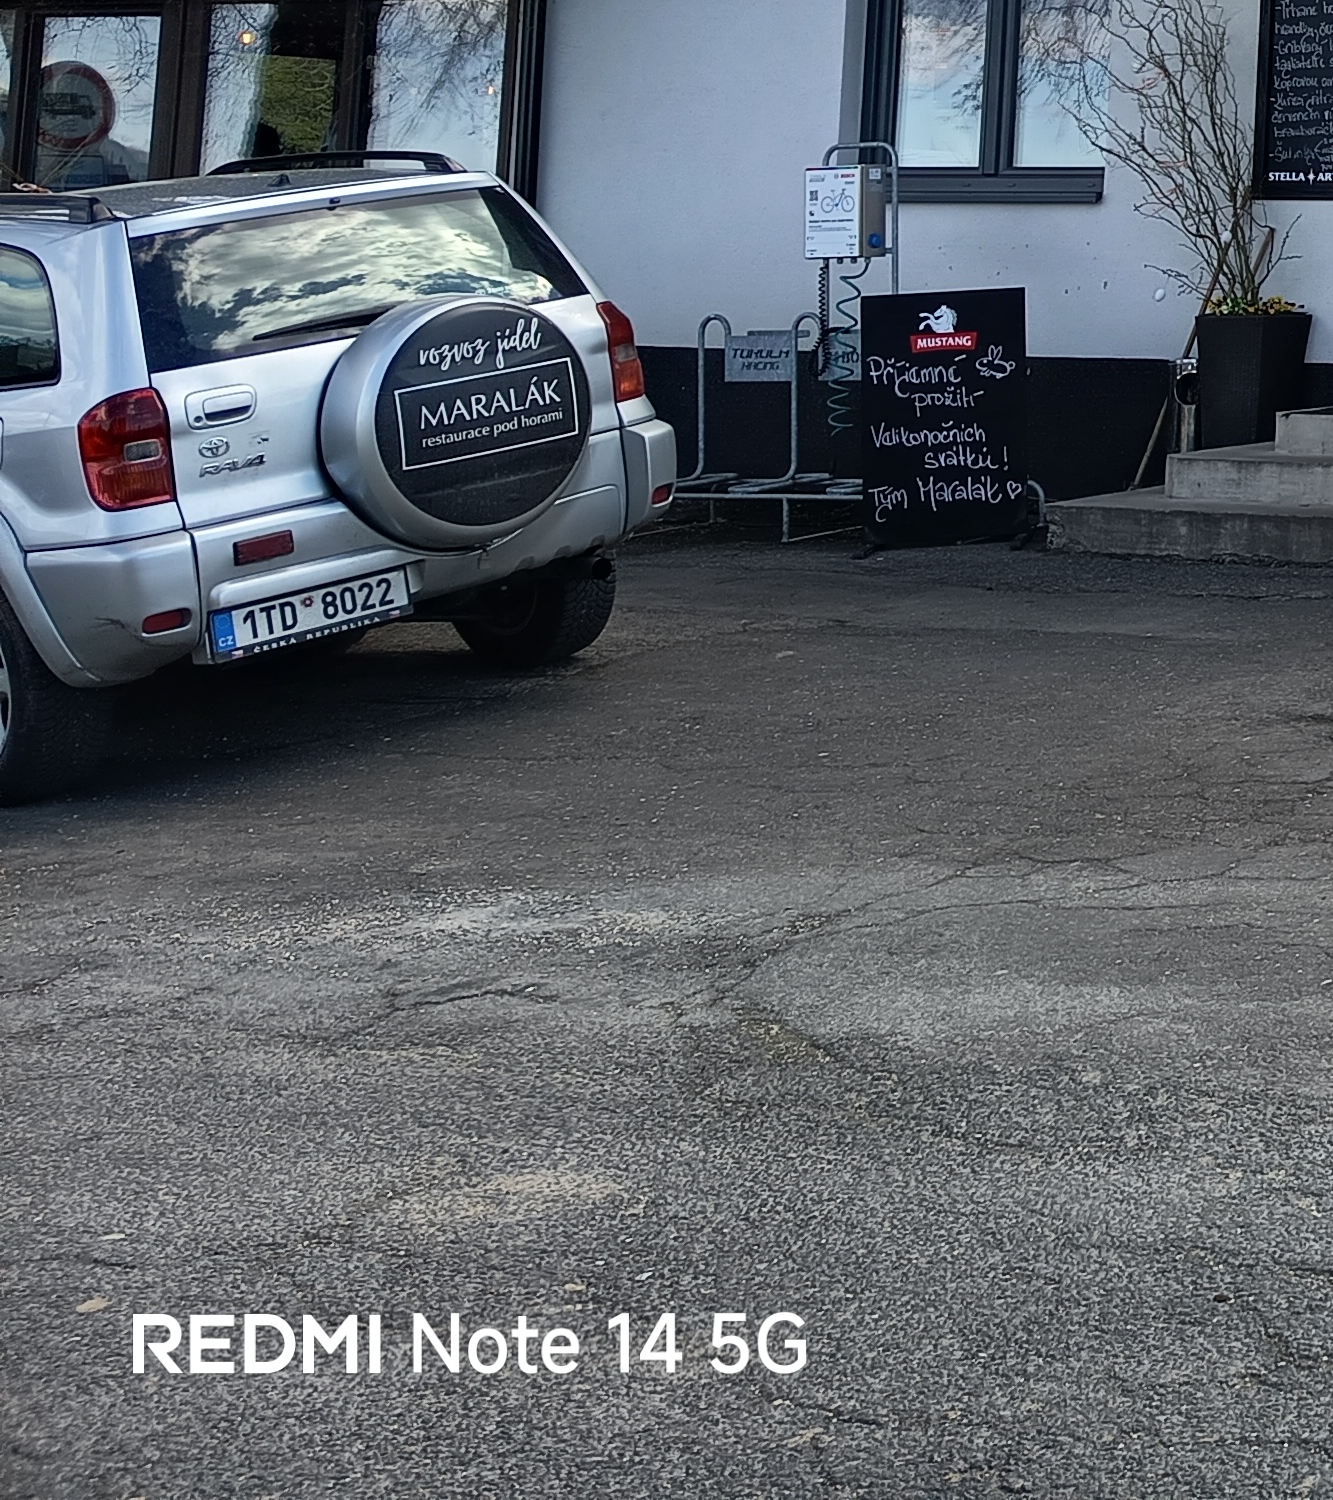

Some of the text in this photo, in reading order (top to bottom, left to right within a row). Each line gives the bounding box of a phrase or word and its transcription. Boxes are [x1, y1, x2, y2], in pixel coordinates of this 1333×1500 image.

[1267, 171, 1306, 182] STELLA
[418, 316, 542, 372] rozvoz jídel
[916, 335, 972, 350] MUSTANG
[866, 354, 967, 398] Příjemné
[420, 376, 562, 430] MARALÁK
[910, 385, 985, 418] prožití
[421, 407, 563, 448] restaurace pod horami
[198, 451, 268, 479] RAV4
[867, 474, 1003, 523] Tým Maralák
[242, 576, 396, 640] 1TD 8022
[218, 635, 234, 647] CZ
[305, 615, 381, 641] REPUBLIKA
